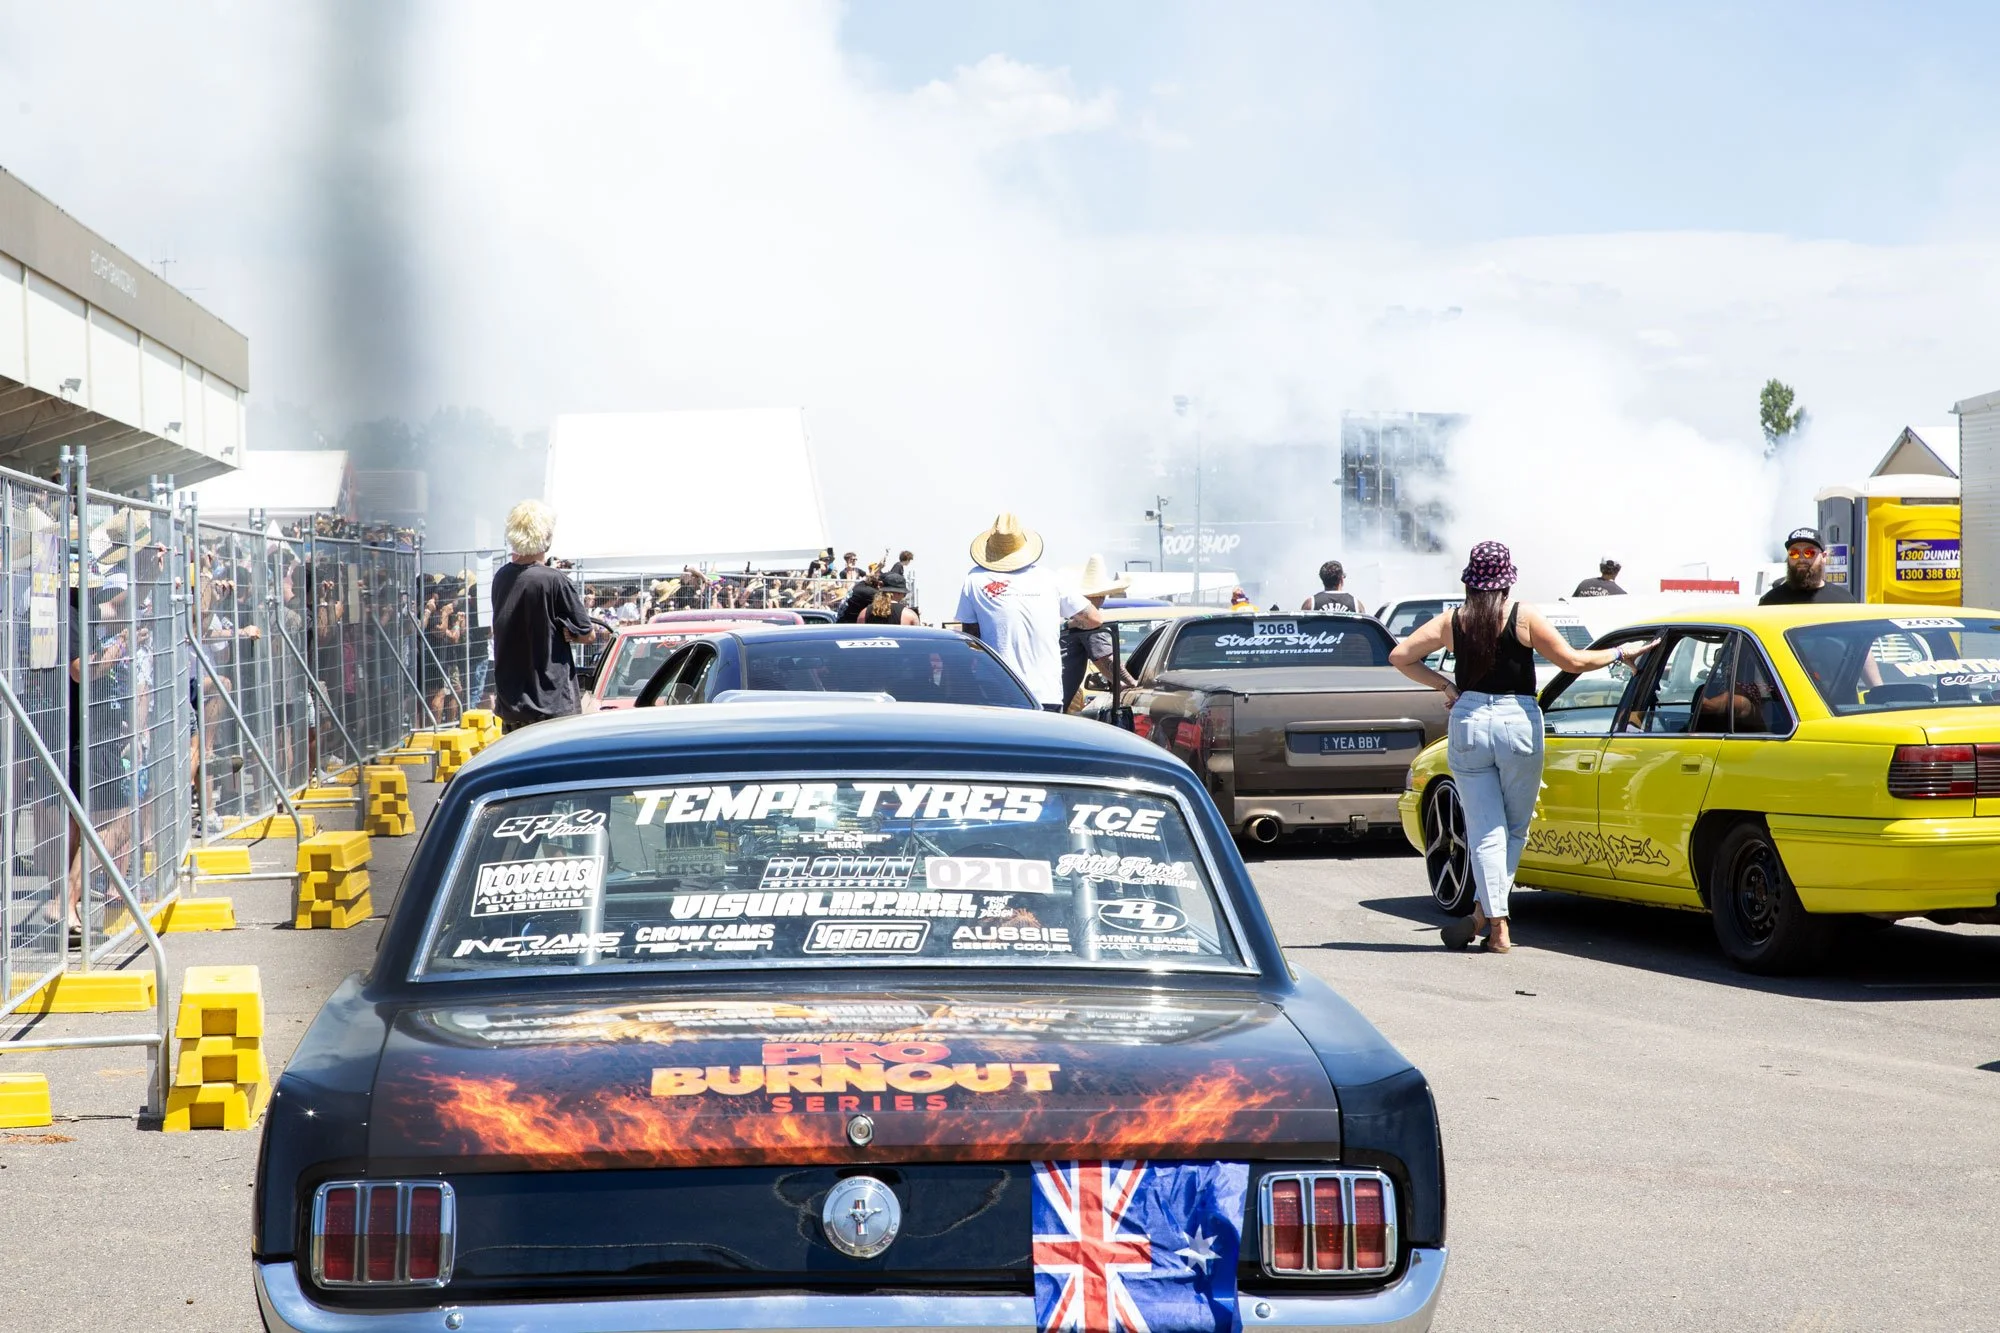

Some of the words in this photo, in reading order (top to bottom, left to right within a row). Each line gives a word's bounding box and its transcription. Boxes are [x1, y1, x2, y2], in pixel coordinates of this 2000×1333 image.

[1163, 534, 1195, 555] ROD
[1901, 569, 1923, 579] 1300
[1926, 569, 1943, 579] 386
[1946, 569, 1960, 579] 697
[1258, 623, 1296, 635] 2068
[1332, 736, 1356, 749] YEA
[1358, 736, 1380, 749] BBY
[633, 783, 839, 825] TEMPE
[852, 783, 1047, 822] TYRES
[1069, 804, 1166, 834] TCE
[1068, 827, 1104, 837] Torque
[1106, 829, 1162, 841] Converters
[827, 841, 863, 849] MEDIA
[763, 856, 917, 880] BLOWN
[929, 859, 1049, 889] 0210
[491, 868, 588, 888] LOVELLS
[770, 879, 904, 888] MOTORSPORTS
[477, 889, 596, 905] AUTOMOTIVE
[486, 899, 584, 912] SYSTEMS
[670, 892, 830, 919] VISUAL
[829, 891, 977, 910] APPAREL
[635, 926, 707, 942] CROW
[708, 924, 776, 940] CAMS
[953, 926, 1070, 942] AUSSIE
[453, 931, 625, 957] INGRAMS
[507, 947, 618, 957] AUTOMOTIVE
[953, 941, 1011, 950] DESERT
[1013, 942, 1072, 952] COOLER
[765, 1032, 947, 1043] SUMMERNATS
[762, 1043, 952, 1064] PRO
[650, 1063, 1061, 1097] BURNOUT
[771, 1095, 948, 1113] SERIES
